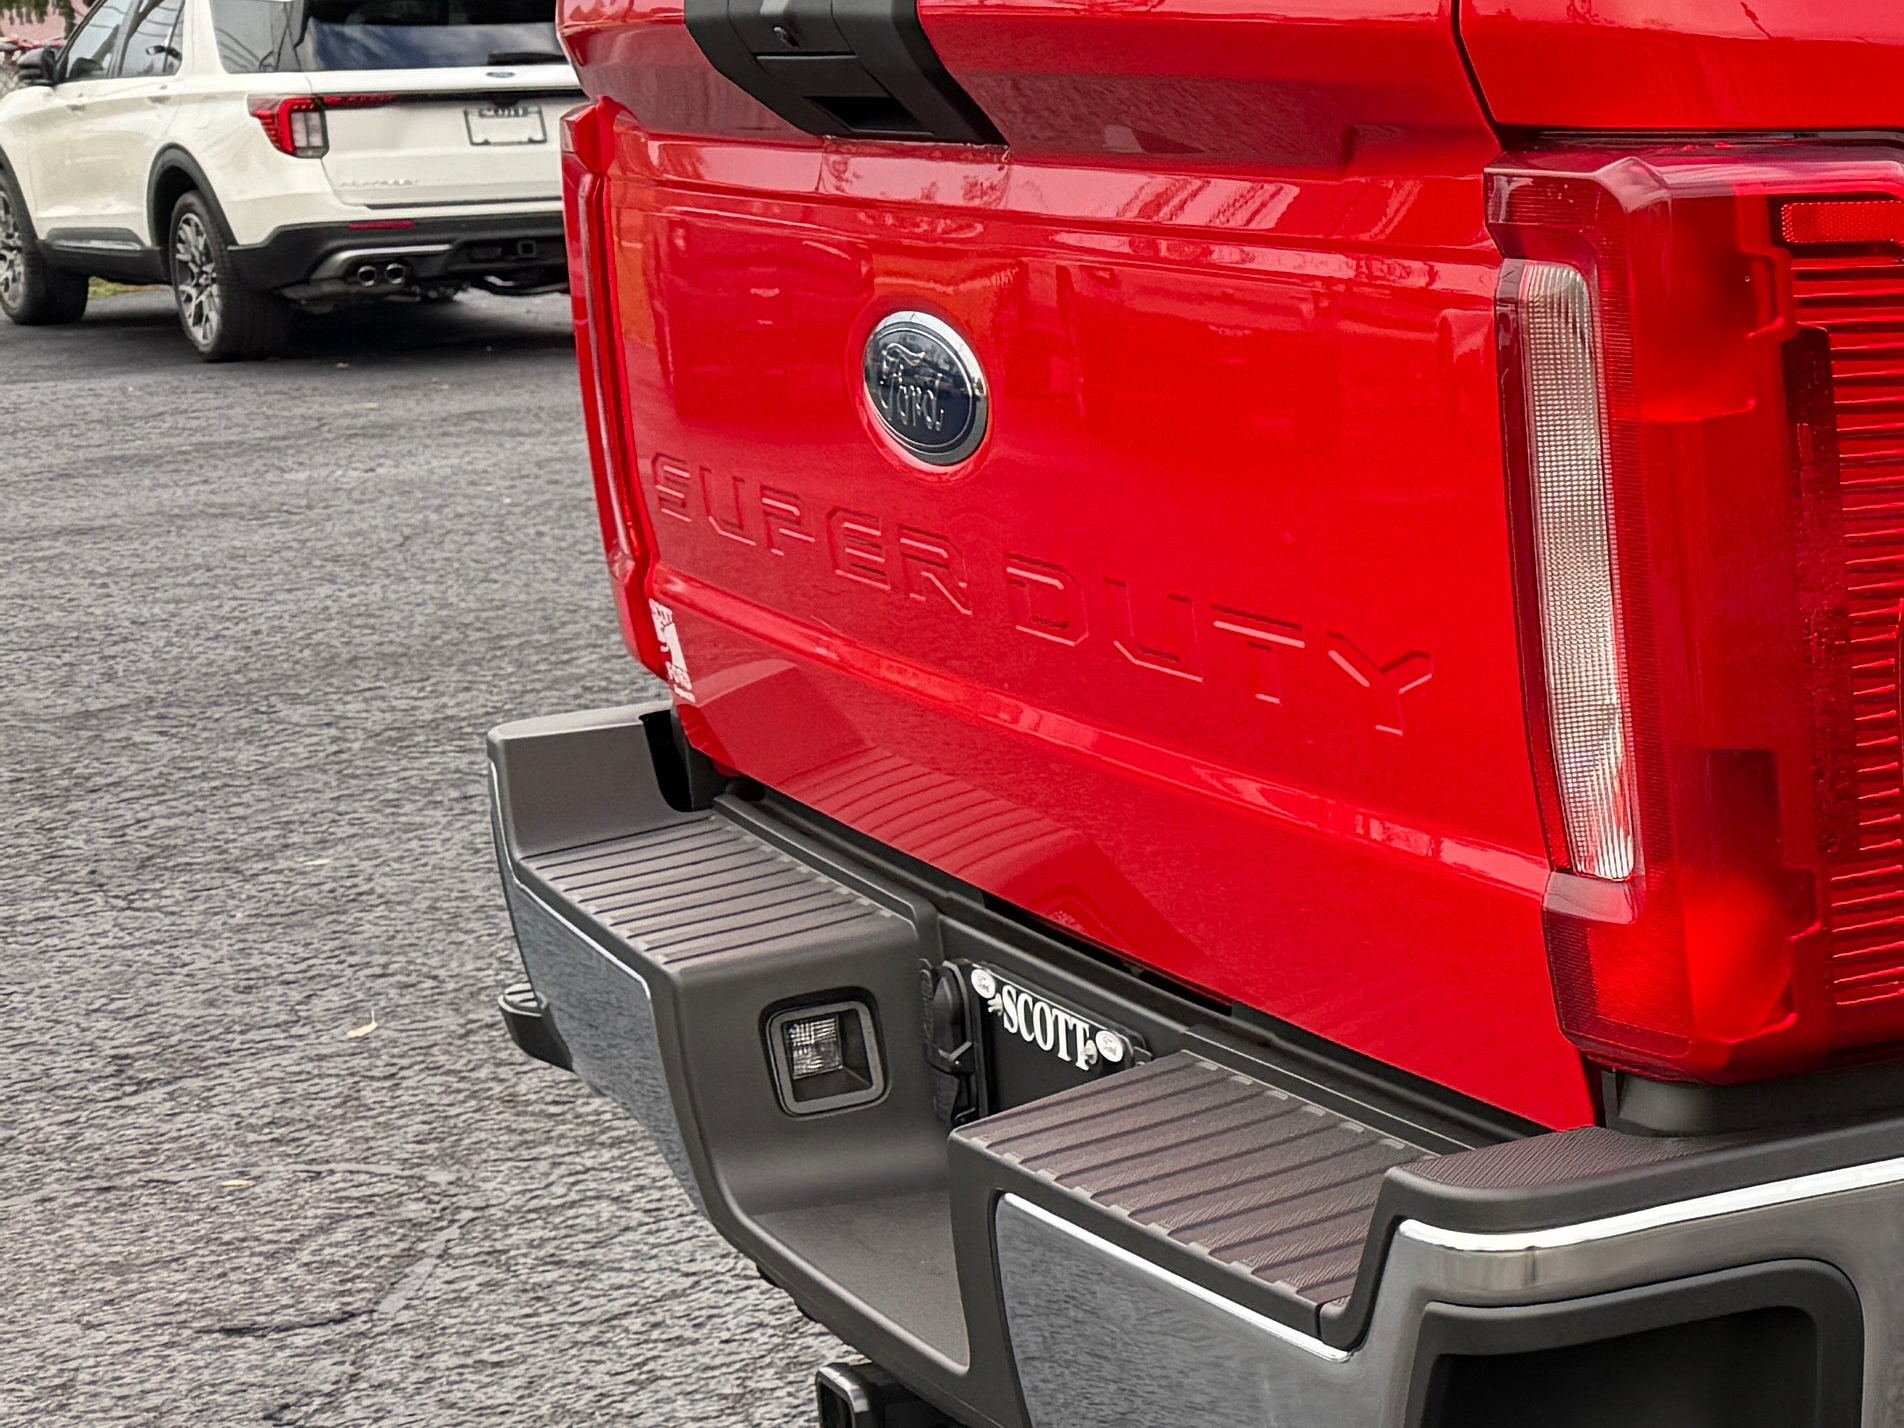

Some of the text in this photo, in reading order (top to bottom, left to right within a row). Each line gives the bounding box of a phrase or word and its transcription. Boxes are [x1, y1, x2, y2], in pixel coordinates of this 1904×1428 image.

[878, 343, 945, 432] Ford
[651, 451, 1434, 736] SUPER DUTY
[1002, 985, 1090, 1071] SCOTT
